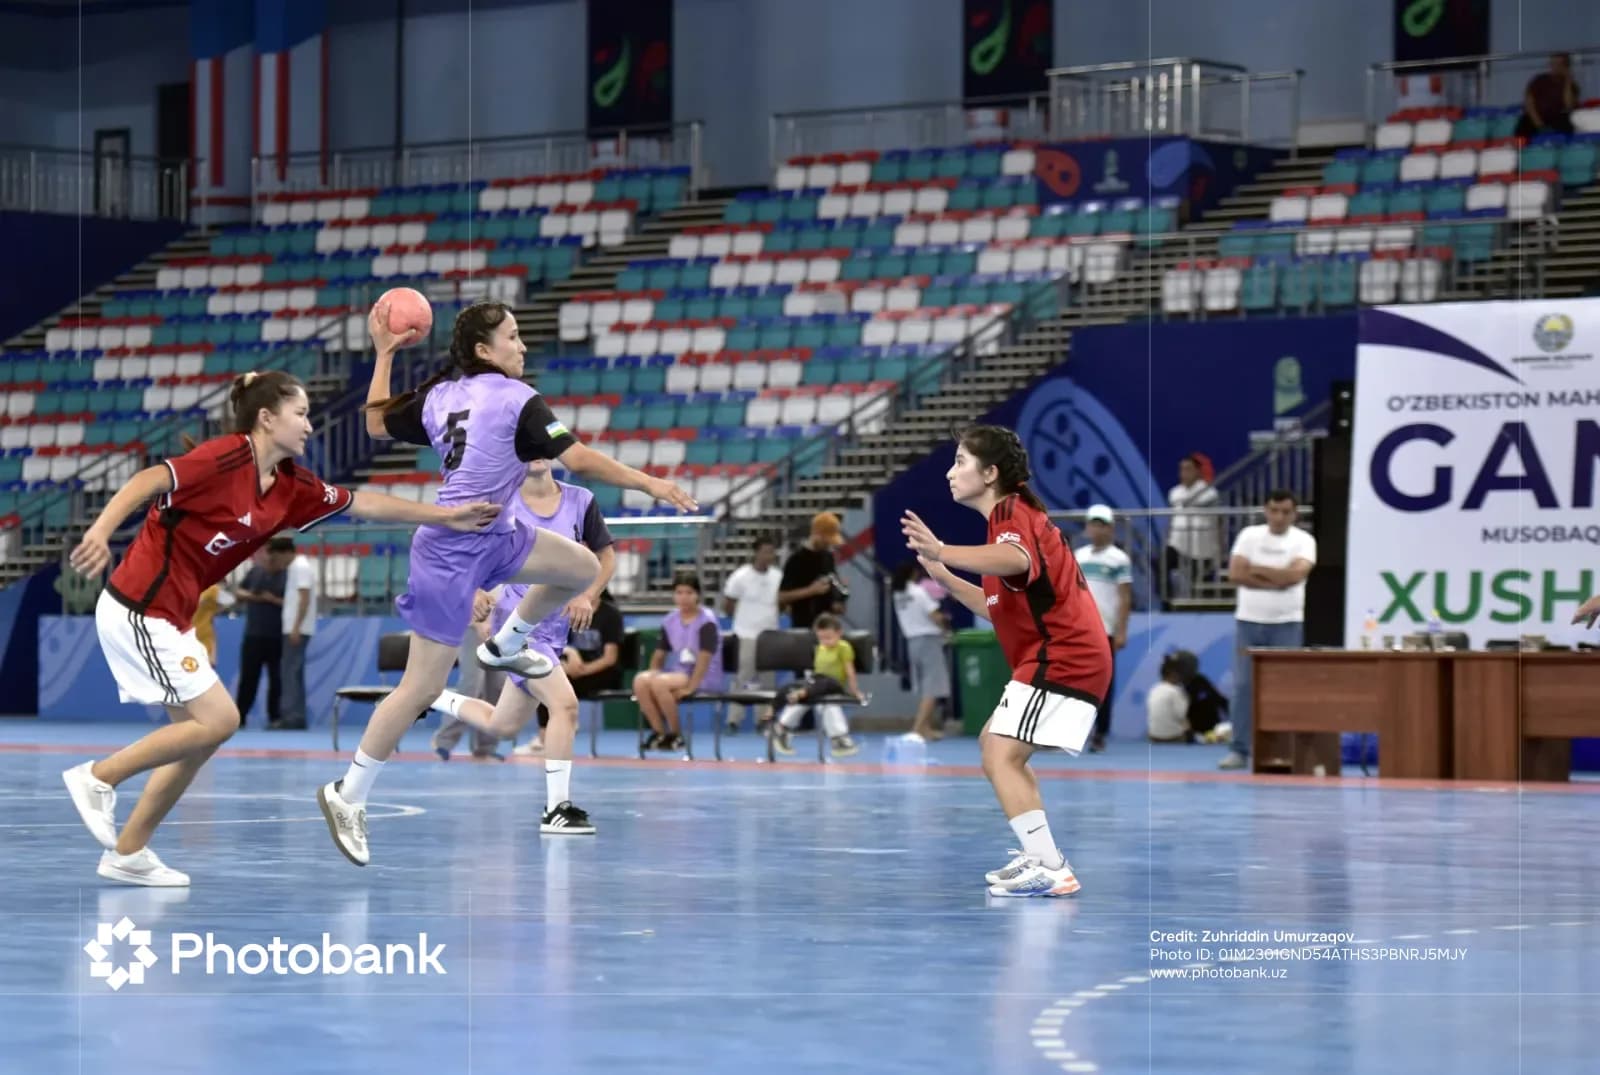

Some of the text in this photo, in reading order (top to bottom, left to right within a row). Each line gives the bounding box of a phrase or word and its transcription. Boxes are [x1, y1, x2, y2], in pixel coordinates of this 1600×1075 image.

[1387, 391, 1540, 413] O'ZBEKISTON
[442, 409, 470, 471] 5
[1369, 419, 1600, 514] GA
[1481, 523, 1600, 546] MUSOBAQ
[1377, 568, 1594, 625] XUSH
